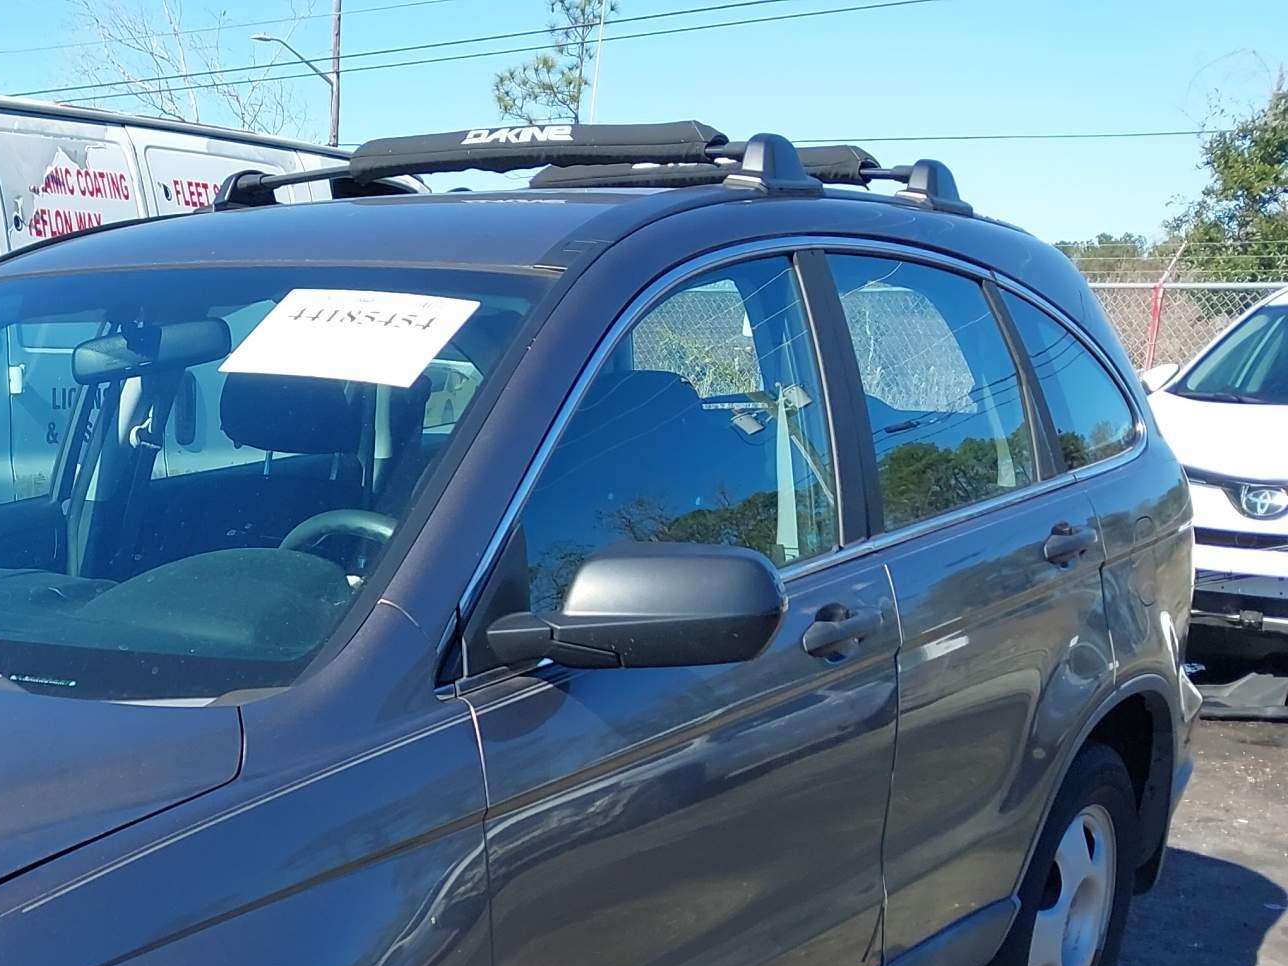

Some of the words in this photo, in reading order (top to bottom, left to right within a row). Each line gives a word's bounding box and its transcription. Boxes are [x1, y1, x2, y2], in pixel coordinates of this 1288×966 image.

[461, 125, 574, 145] DAKINE
[75, 168, 130, 201] COATING
[173, 179, 210, 208] FLEET
